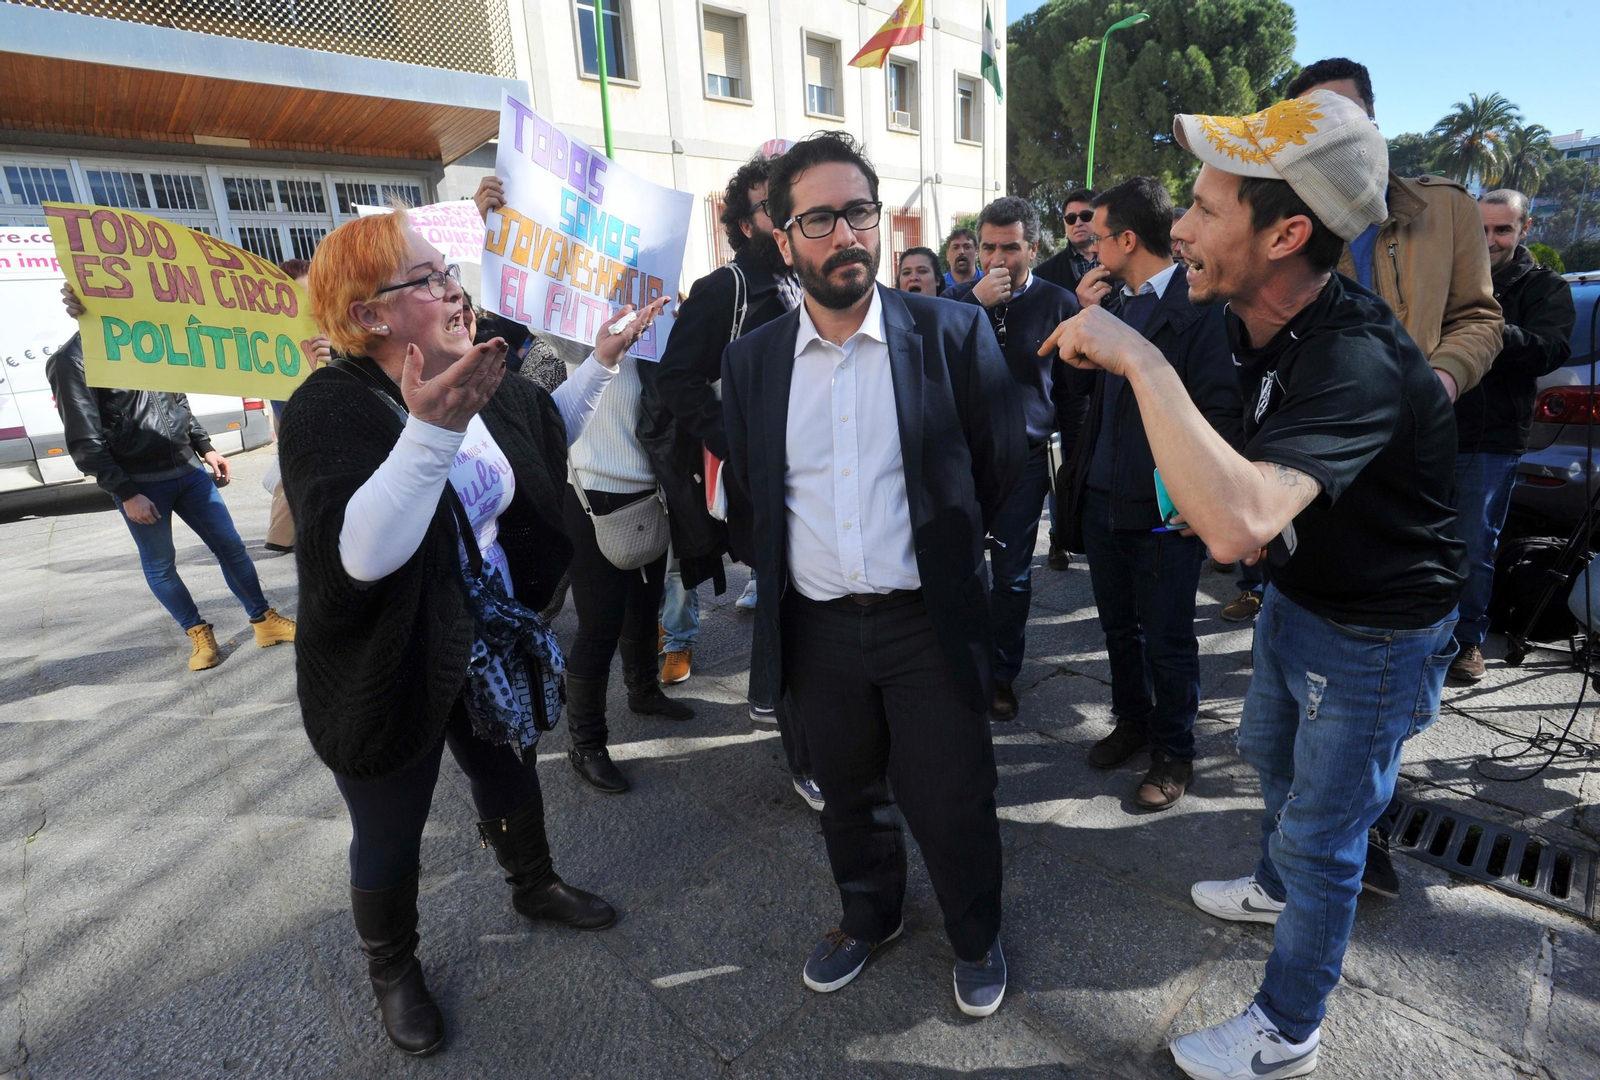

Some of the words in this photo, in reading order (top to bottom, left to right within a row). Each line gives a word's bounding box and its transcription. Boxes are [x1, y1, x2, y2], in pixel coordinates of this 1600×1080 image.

[507, 95, 607, 205] TODOS
[763, 139, 787, 158] NO
[44, 206, 177, 259] TODO
[449, 244, 482, 258] AYU
[559, 186, 640, 266] SOMOS
[71, 254, 134, 298] ES
[148, 263, 205, 305] UN
[501, 265, 532, 324] EL
[544, 281, 657, 359] FUTO
